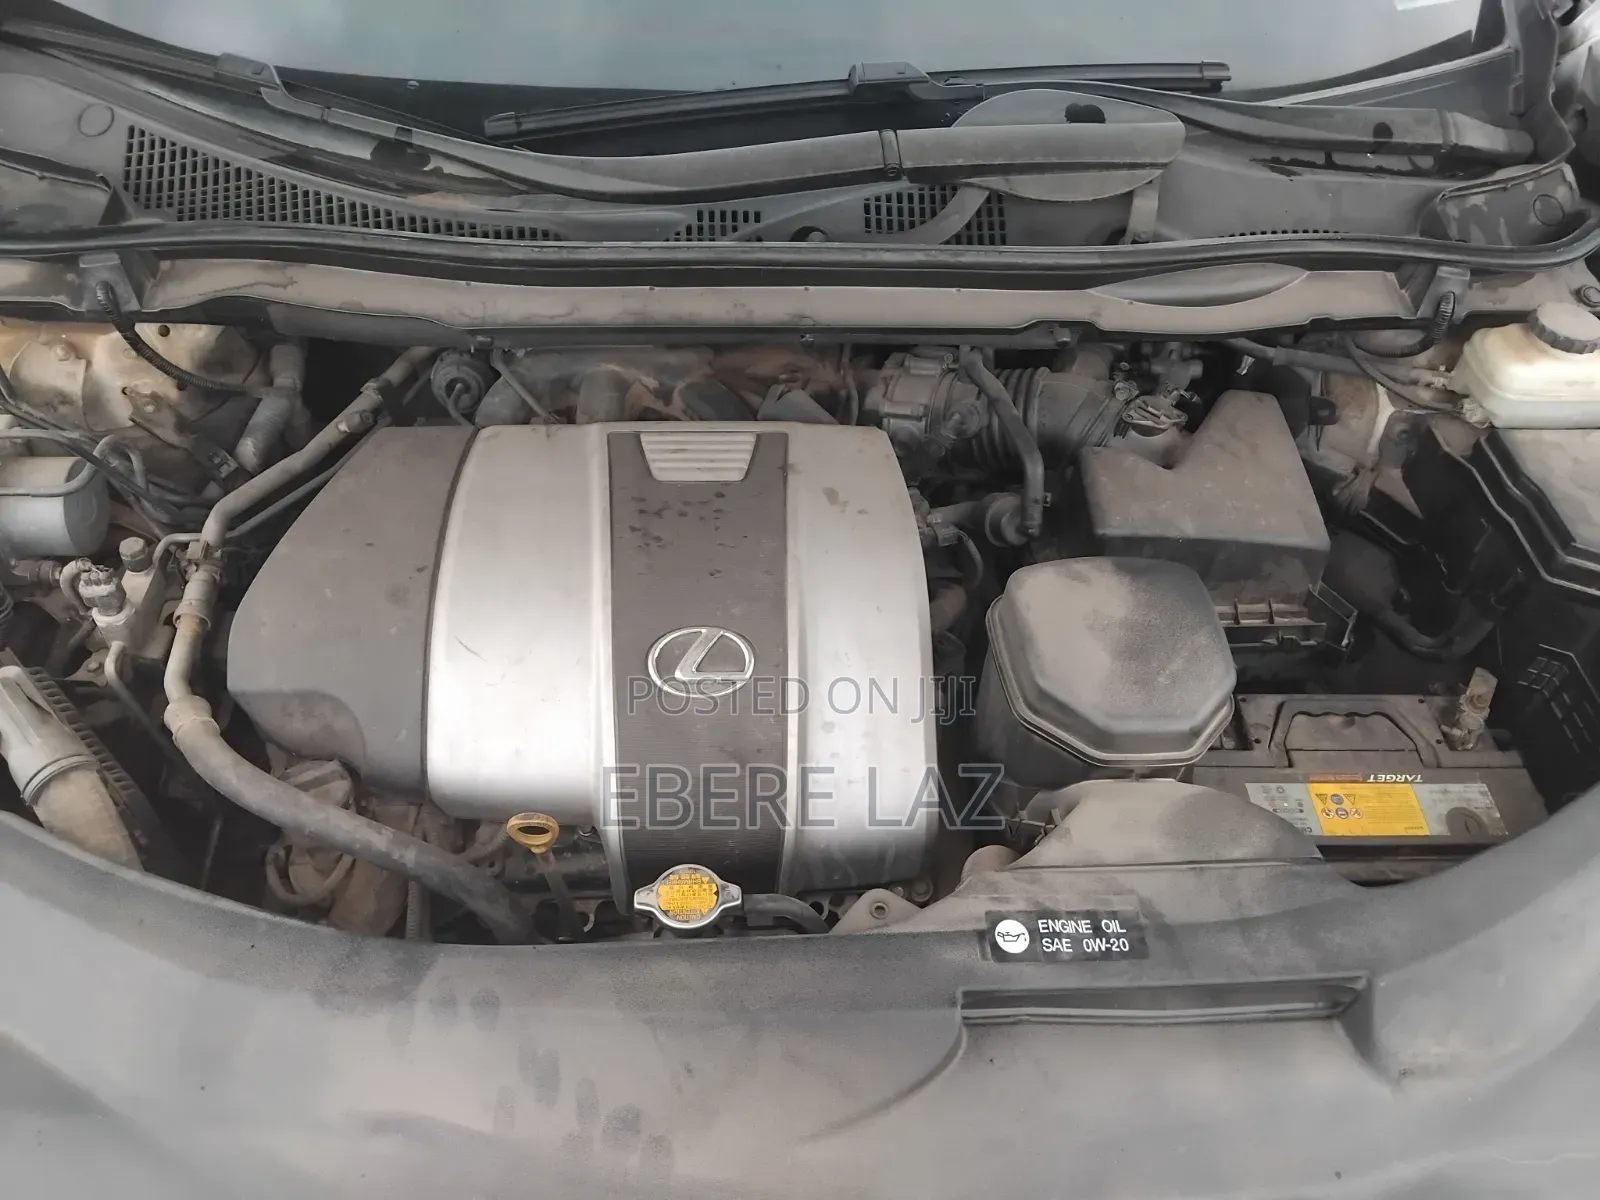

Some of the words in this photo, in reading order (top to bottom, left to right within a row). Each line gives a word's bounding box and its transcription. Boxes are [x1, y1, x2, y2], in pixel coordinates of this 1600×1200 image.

[1367, 774, 1423, 783] TARGET
[1038, 919, 1093, 934] ENGINE
[1101, 919, 1127, 933] OIL
[1041, 938, 1073, 952] SAE
[1083, 937, 1130, 952] 0W-20
